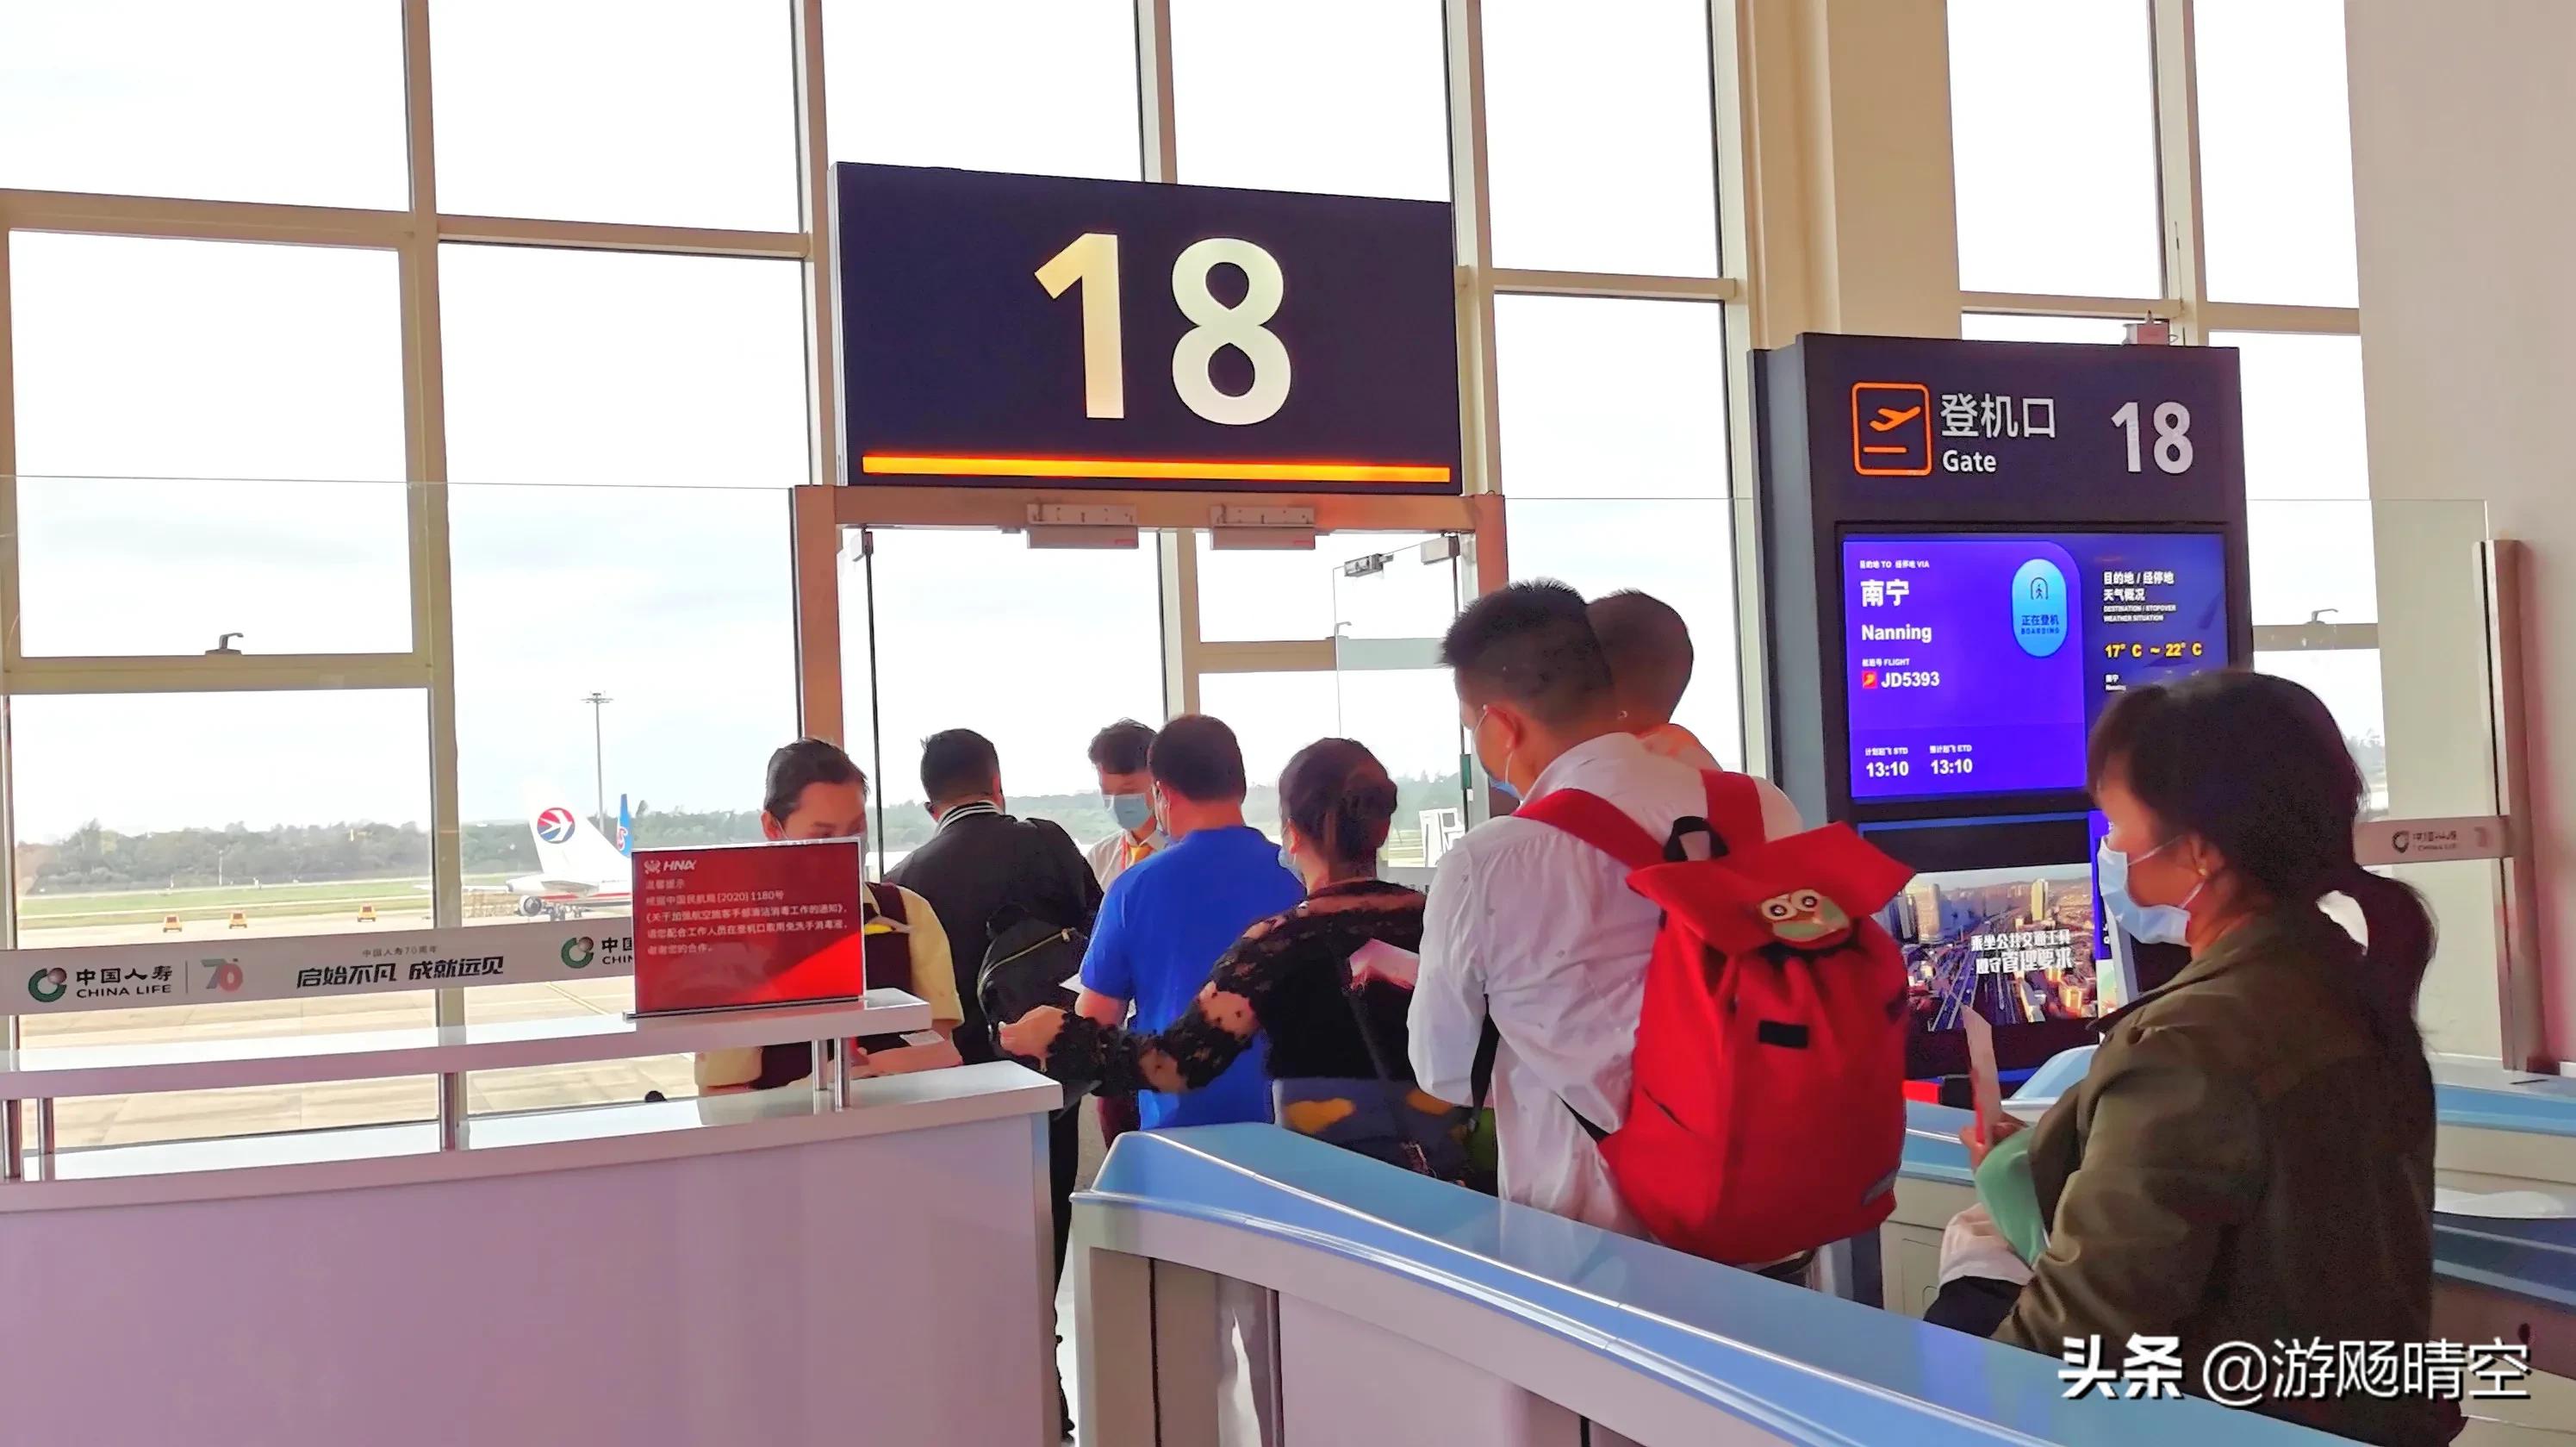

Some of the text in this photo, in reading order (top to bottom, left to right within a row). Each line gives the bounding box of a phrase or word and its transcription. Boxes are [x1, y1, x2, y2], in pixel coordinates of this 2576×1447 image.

[1034, 233, 1292, 426] 18
[1940, 393, 2056, 439] 登机口
[2111, 402, 2193, 474] 18
[1942, 450, 1996, 473] Gate
[1881, 560, 1892, 569] TO
[2103, 571, 2135, 585] 目的地
[2143, 571, 2175, 584] 经停地
[1860, 578, 1910, 607] 南宁
[2103, 588, 2146, 602] 天气概况
[2021, 614, 2059, 626] 正在登机
[1861, 624, 1932, 643] Nanning
[1881, 670, 1940, 688] JD5393
[1866, 760, 1909, 777] 13:10
[1931, 758, 1973, 775] 13:10
[1971, 929, 2070, 951] 乘坐公共交通工具
[76, 965, 172, 986] 中国人寿
[296, 956, 504, 989] 启始不凡 成就远见
[77, 984, 171, 999] CHINA LIFE
